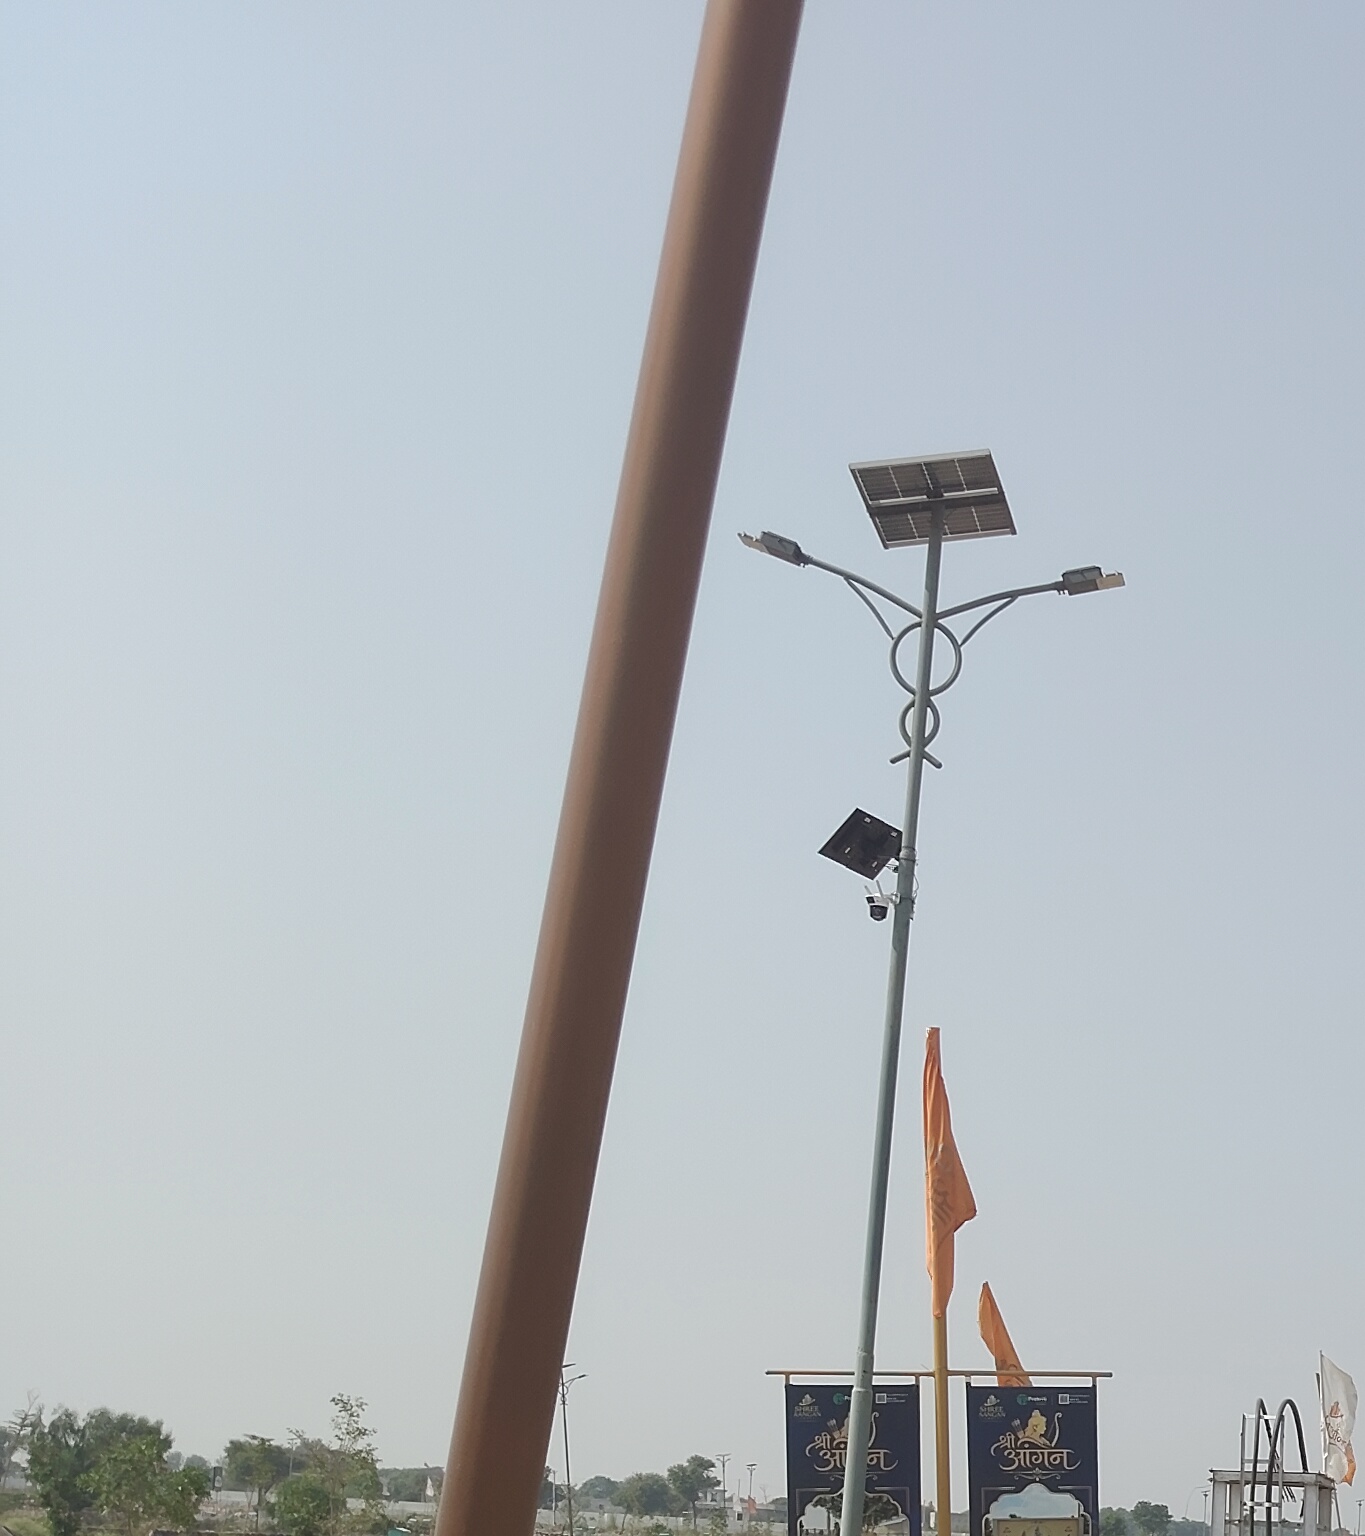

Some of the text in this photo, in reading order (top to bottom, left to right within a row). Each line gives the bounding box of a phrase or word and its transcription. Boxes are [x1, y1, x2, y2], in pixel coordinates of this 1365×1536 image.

[805, 1432, 832, 1457] श्री
[990, 1431, 1016, 1457] श्री
[998, 1443, 1082, 1470] आंगन
[813, 1444, 899, 1471] आंन
